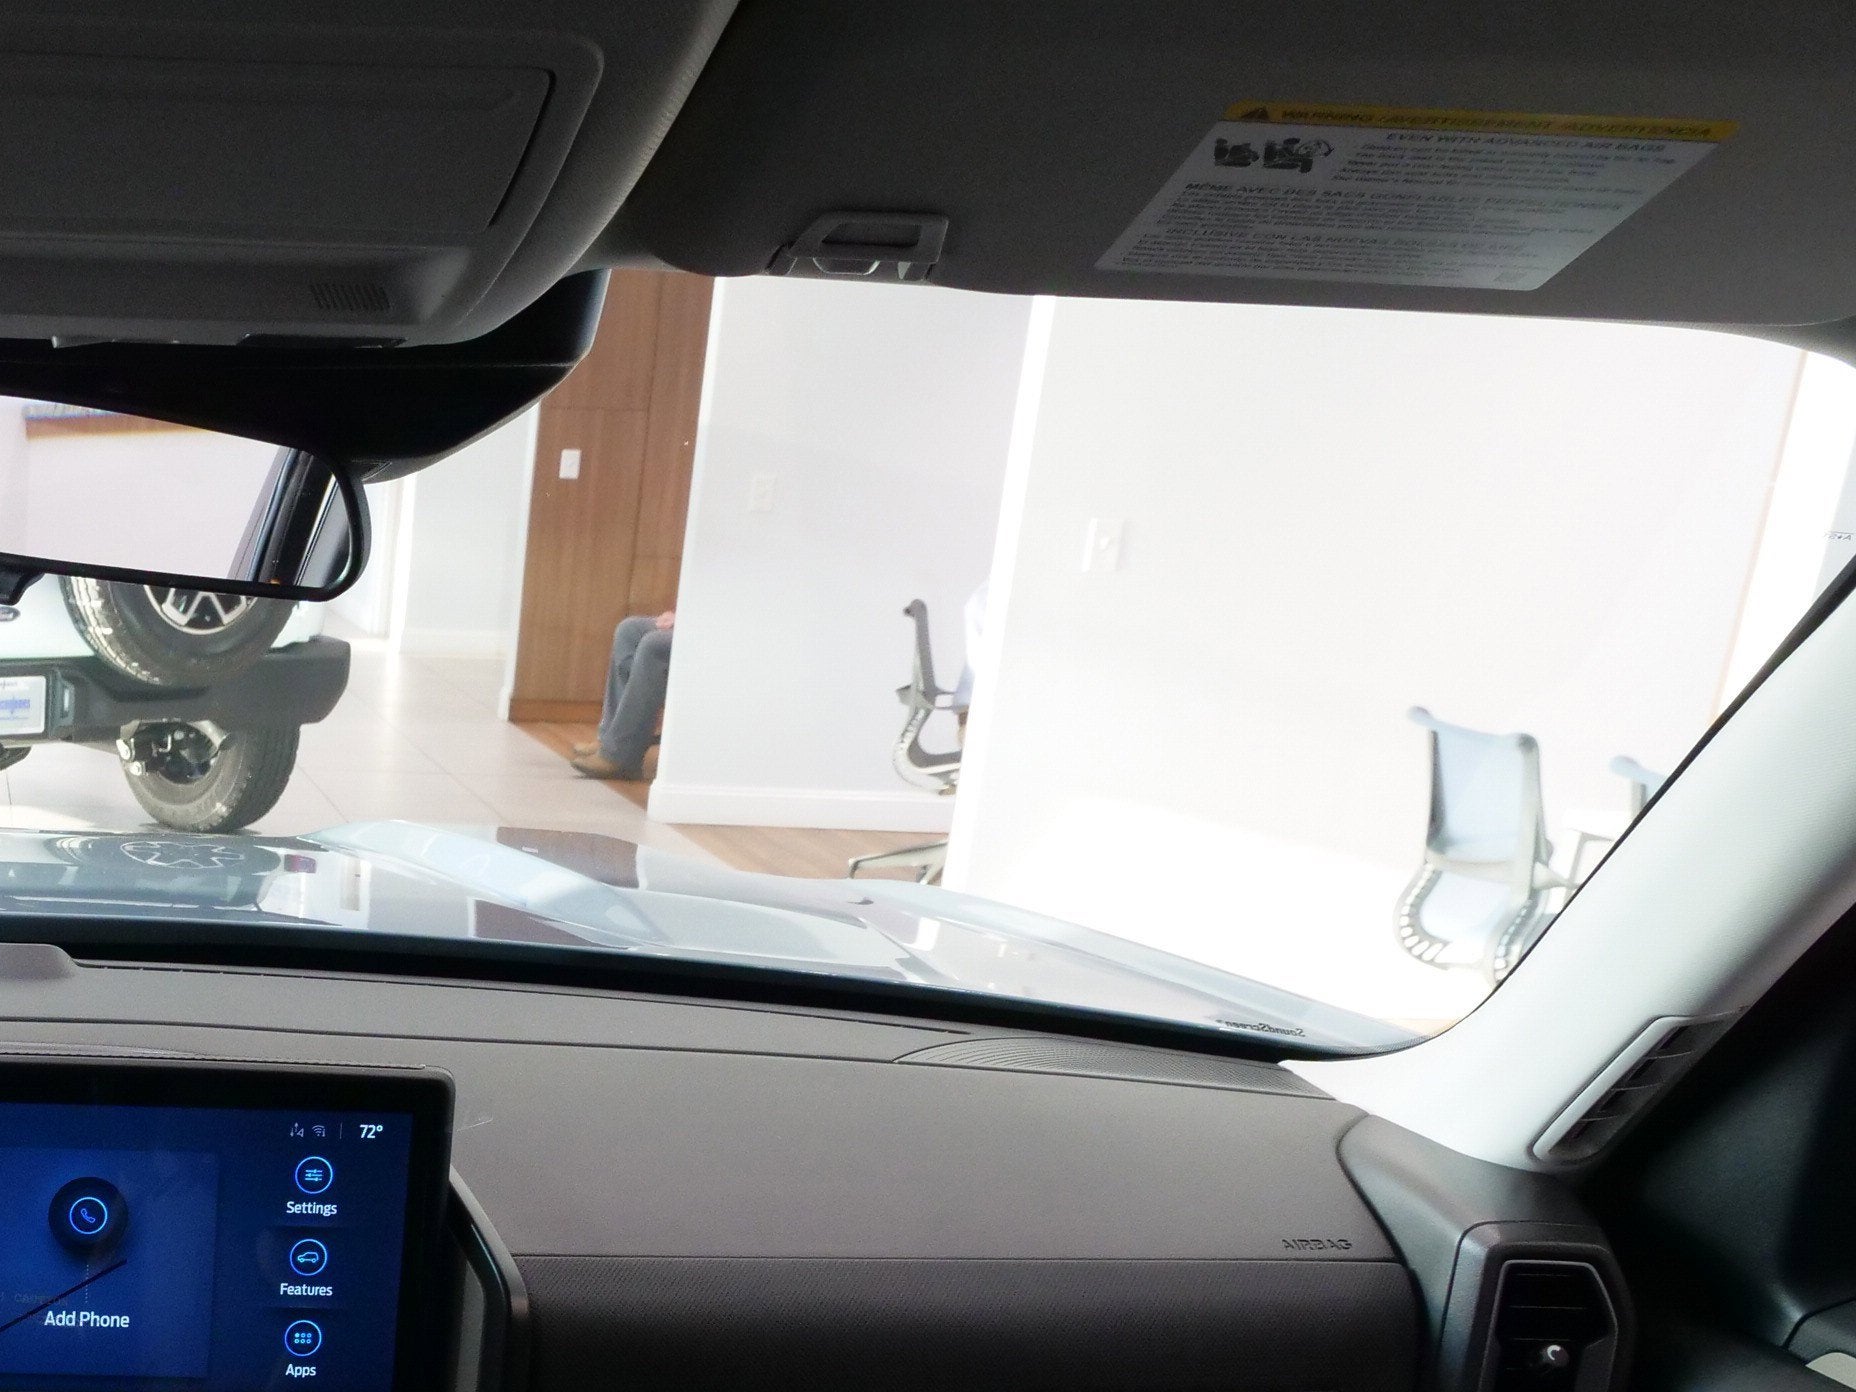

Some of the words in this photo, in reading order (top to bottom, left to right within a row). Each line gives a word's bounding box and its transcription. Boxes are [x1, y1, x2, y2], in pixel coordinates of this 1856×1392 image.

[359, 1123, 384, 1139] 72°
[286, 1201, 338, 1217] Settings
[1281, 1237, 1353, 1252] AIRBAG
[279, 1283, 333, 1297] Features
[44, 1310, 76, 1328] Add
[79, 1311, 130, 1329] Phone
[285, 1363, 317, 1378] Apps
